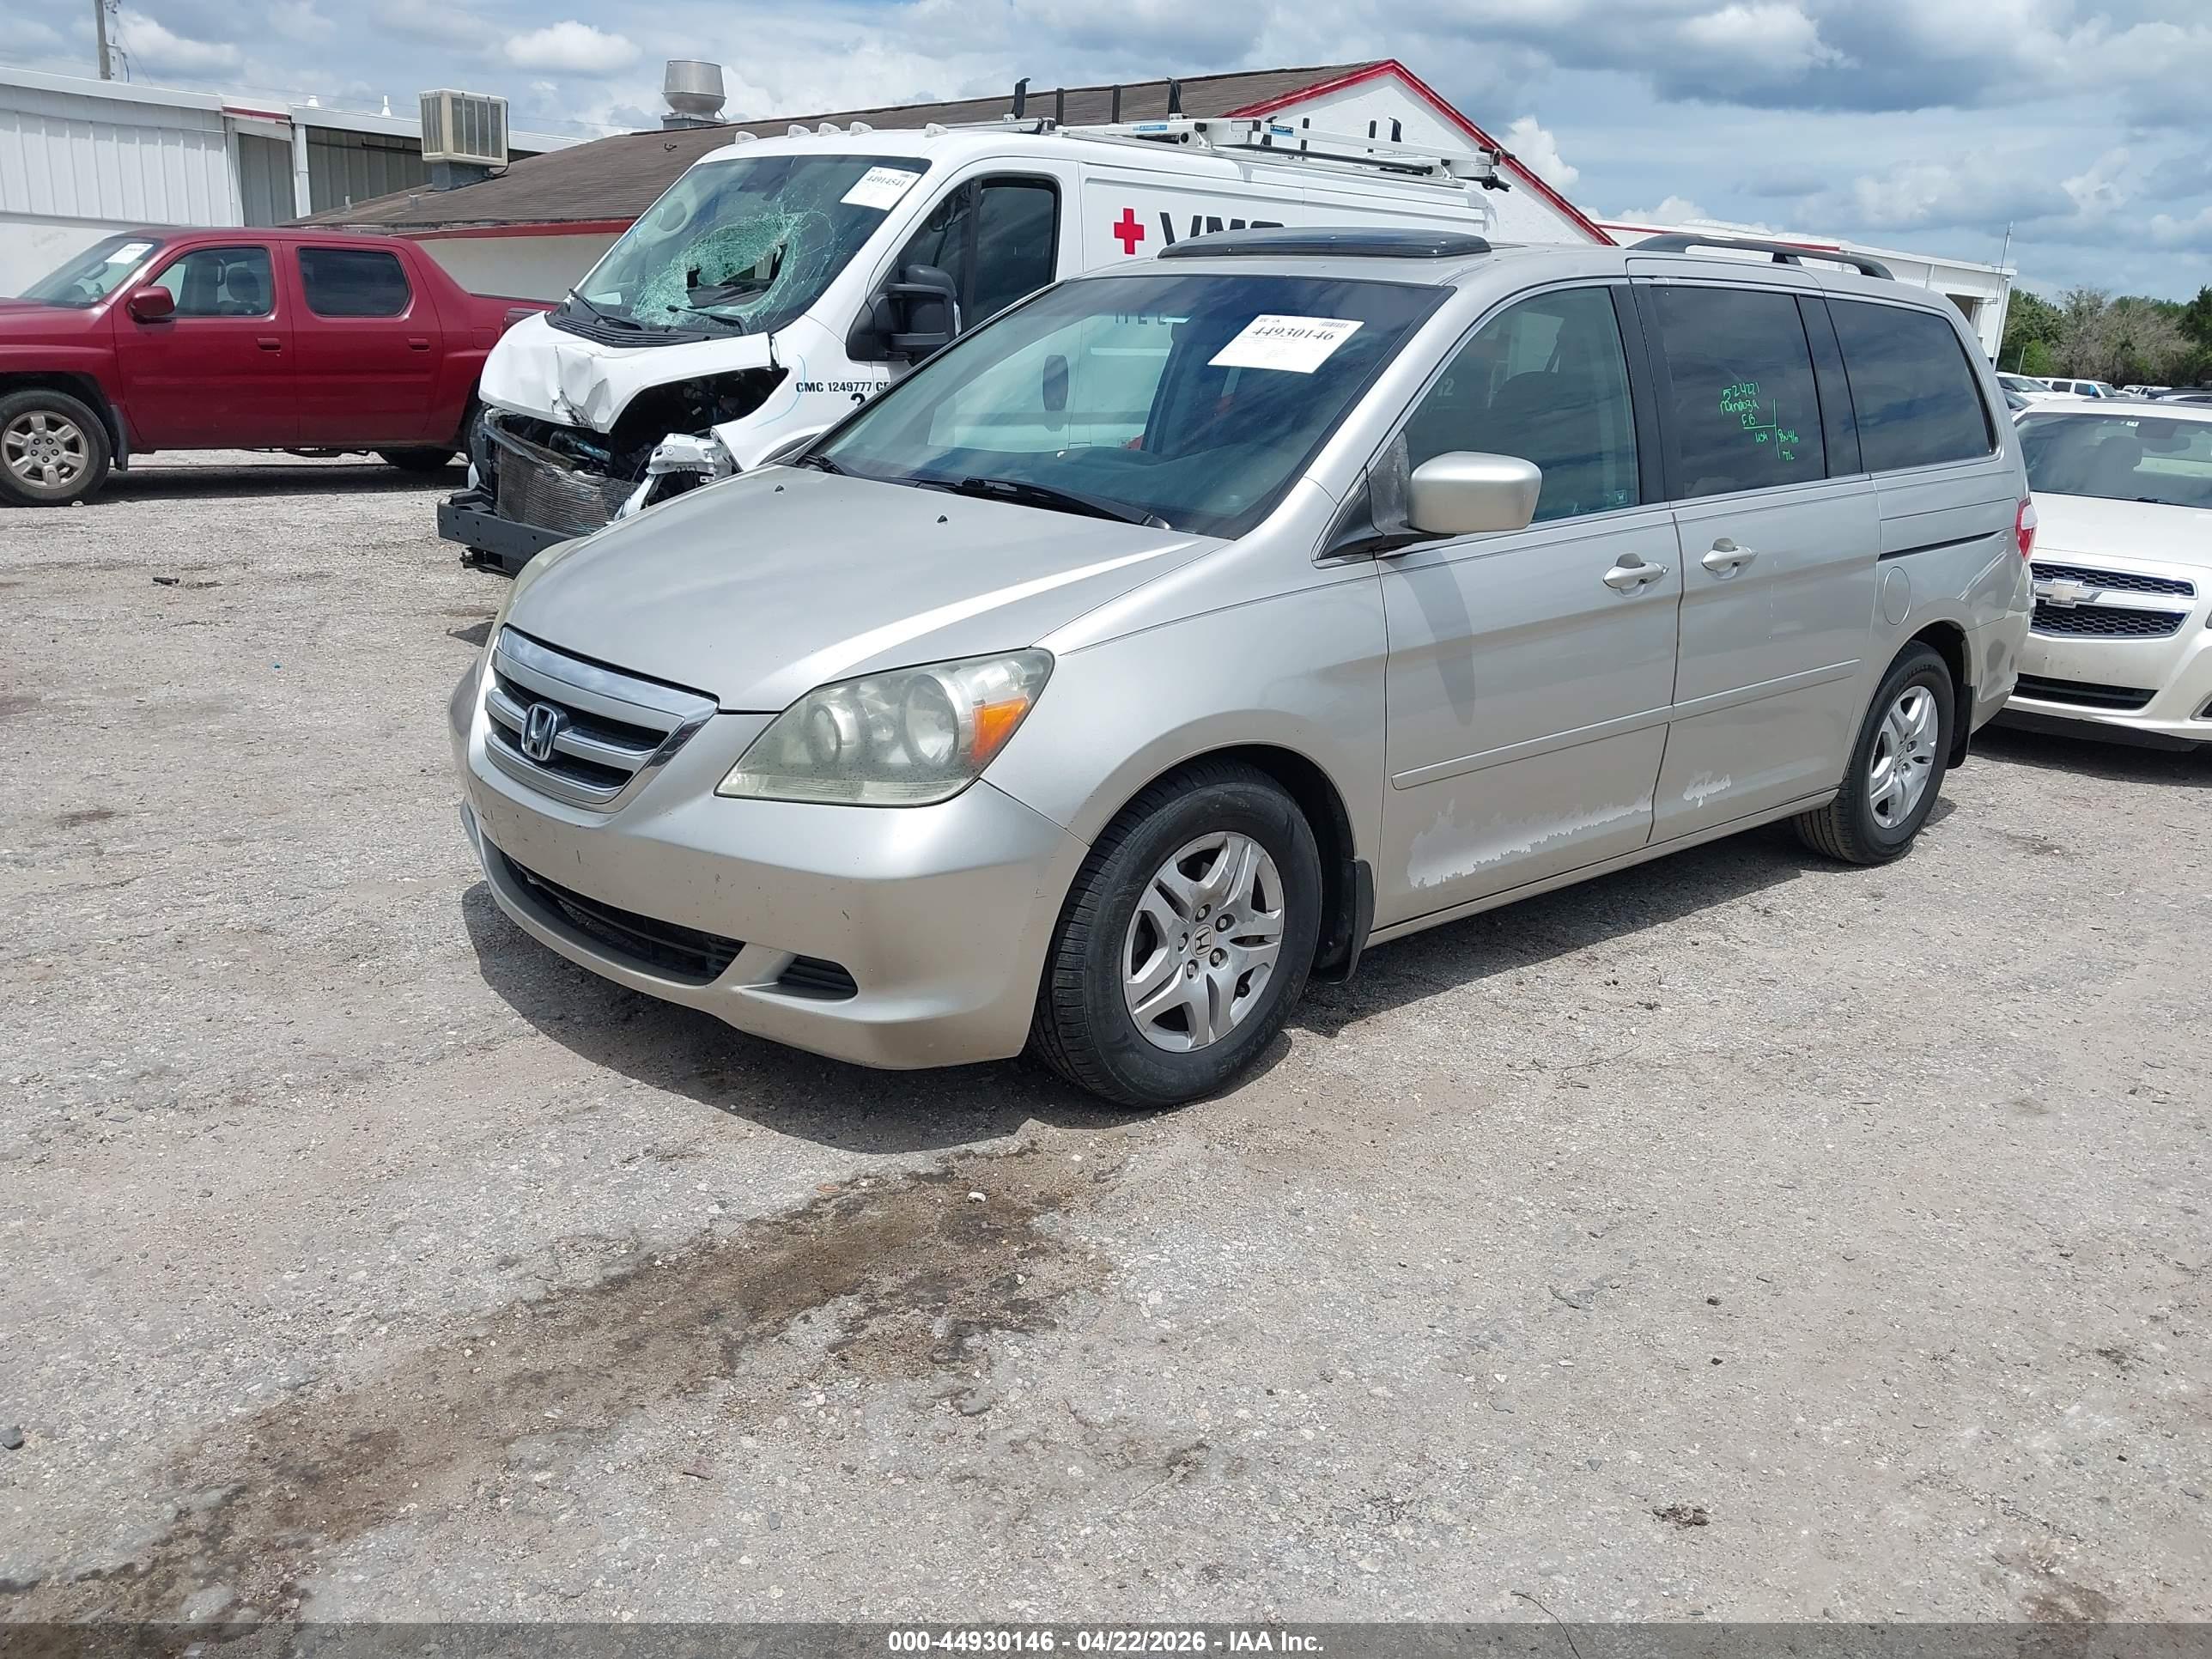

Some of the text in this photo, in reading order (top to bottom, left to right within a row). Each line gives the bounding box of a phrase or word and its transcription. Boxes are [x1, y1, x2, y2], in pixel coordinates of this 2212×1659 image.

[1251, 325, 1340, 341] 44930146
[795, 381, 824, 392] CMC
[828, 381, 872, 392] 1249777
